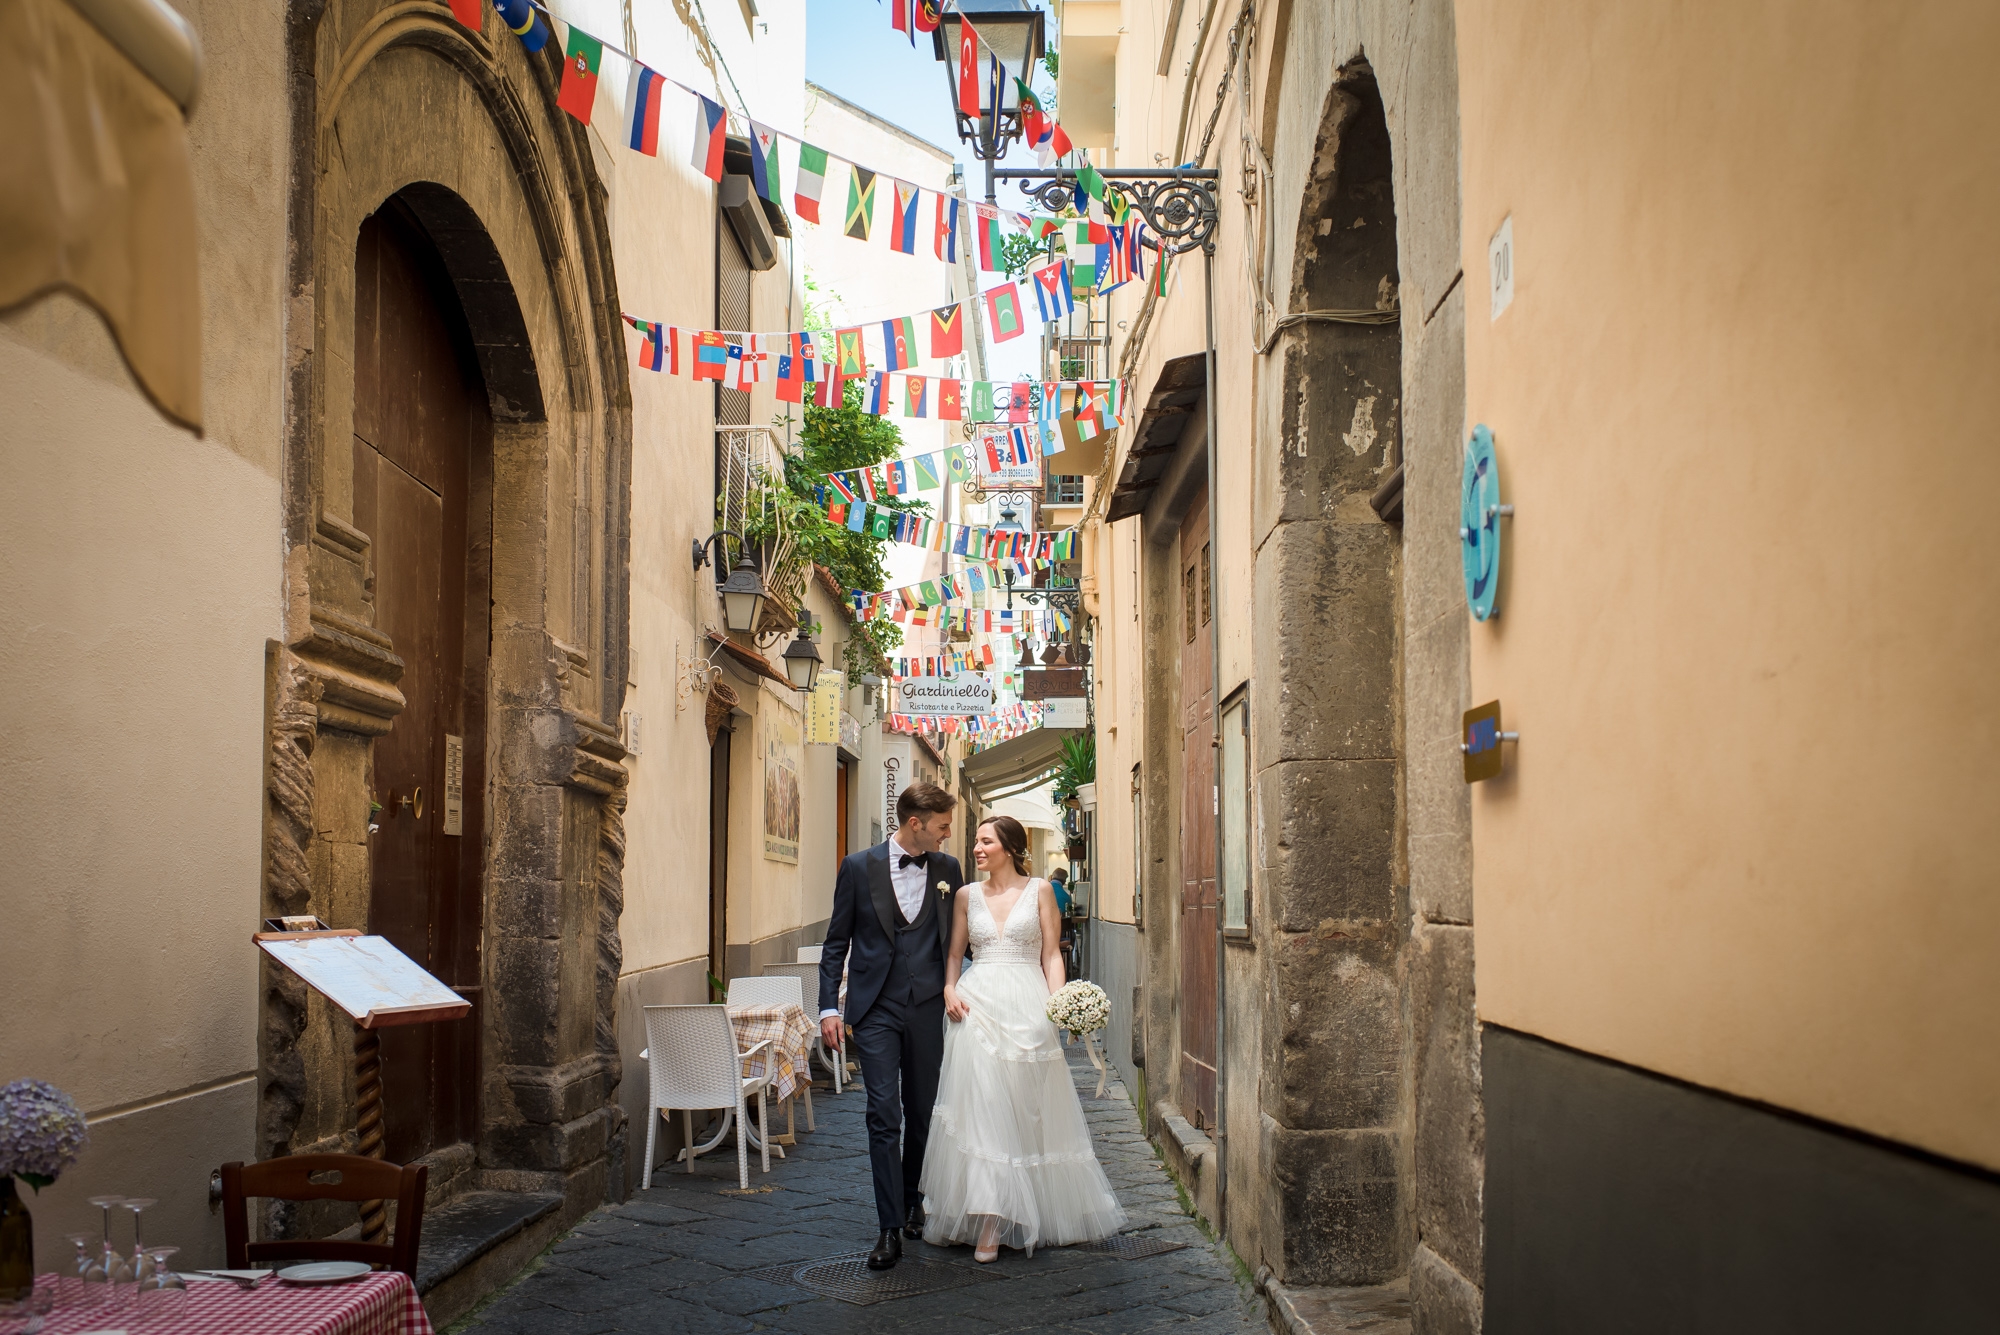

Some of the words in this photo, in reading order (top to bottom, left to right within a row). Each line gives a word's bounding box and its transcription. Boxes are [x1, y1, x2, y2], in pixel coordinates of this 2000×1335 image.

[1495, 242, 1509, 292] 20
[902, 683, 989, 699] Giardiniello
[1027, 680, 1084, 692] stoviglie
[909, 702, 948, 711] Ristorante
[956, 702, 984, 712] Pizzeria
